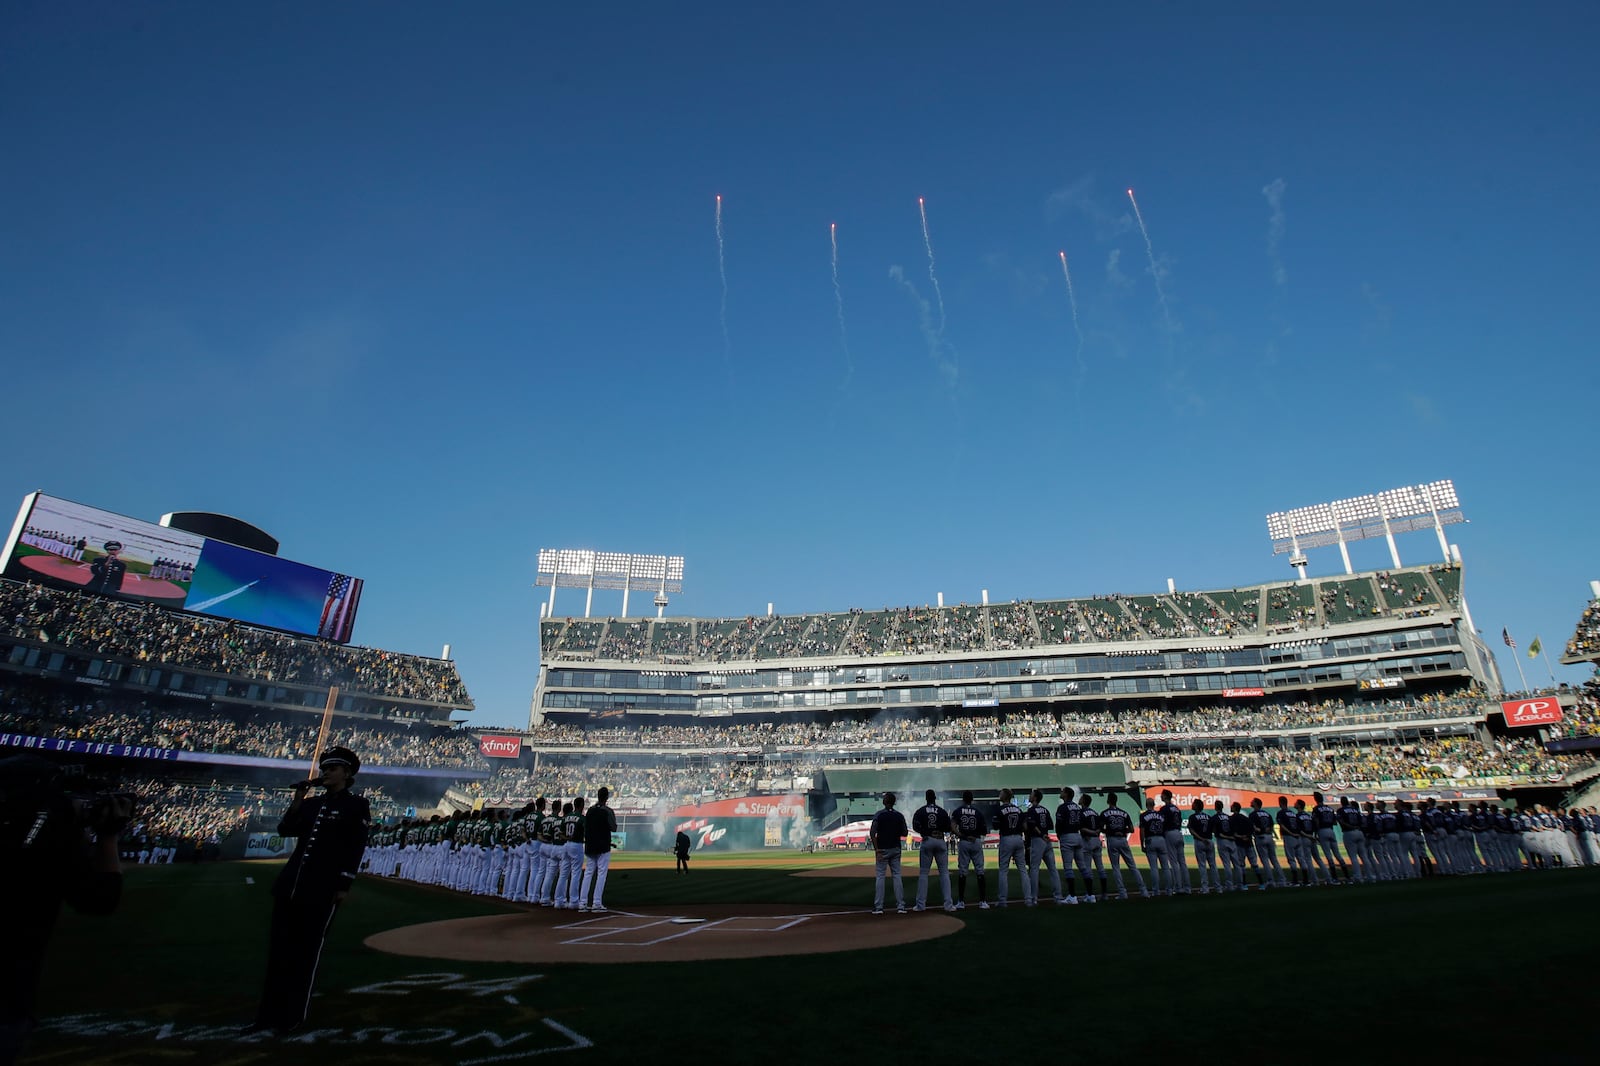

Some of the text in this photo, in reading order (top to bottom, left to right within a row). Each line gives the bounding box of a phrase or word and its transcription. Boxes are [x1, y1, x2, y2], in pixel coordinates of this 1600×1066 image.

[1225, 689, 1262, 697] Budweiser
[0, 733, 172, 760] HOME OF THE BRAVE
[481, 739, 519, 754] xfinity
[928, 813, 937, 829] 2
[960, 814, 977, 831] 29
[1007, 813, 1019, 829] 17
